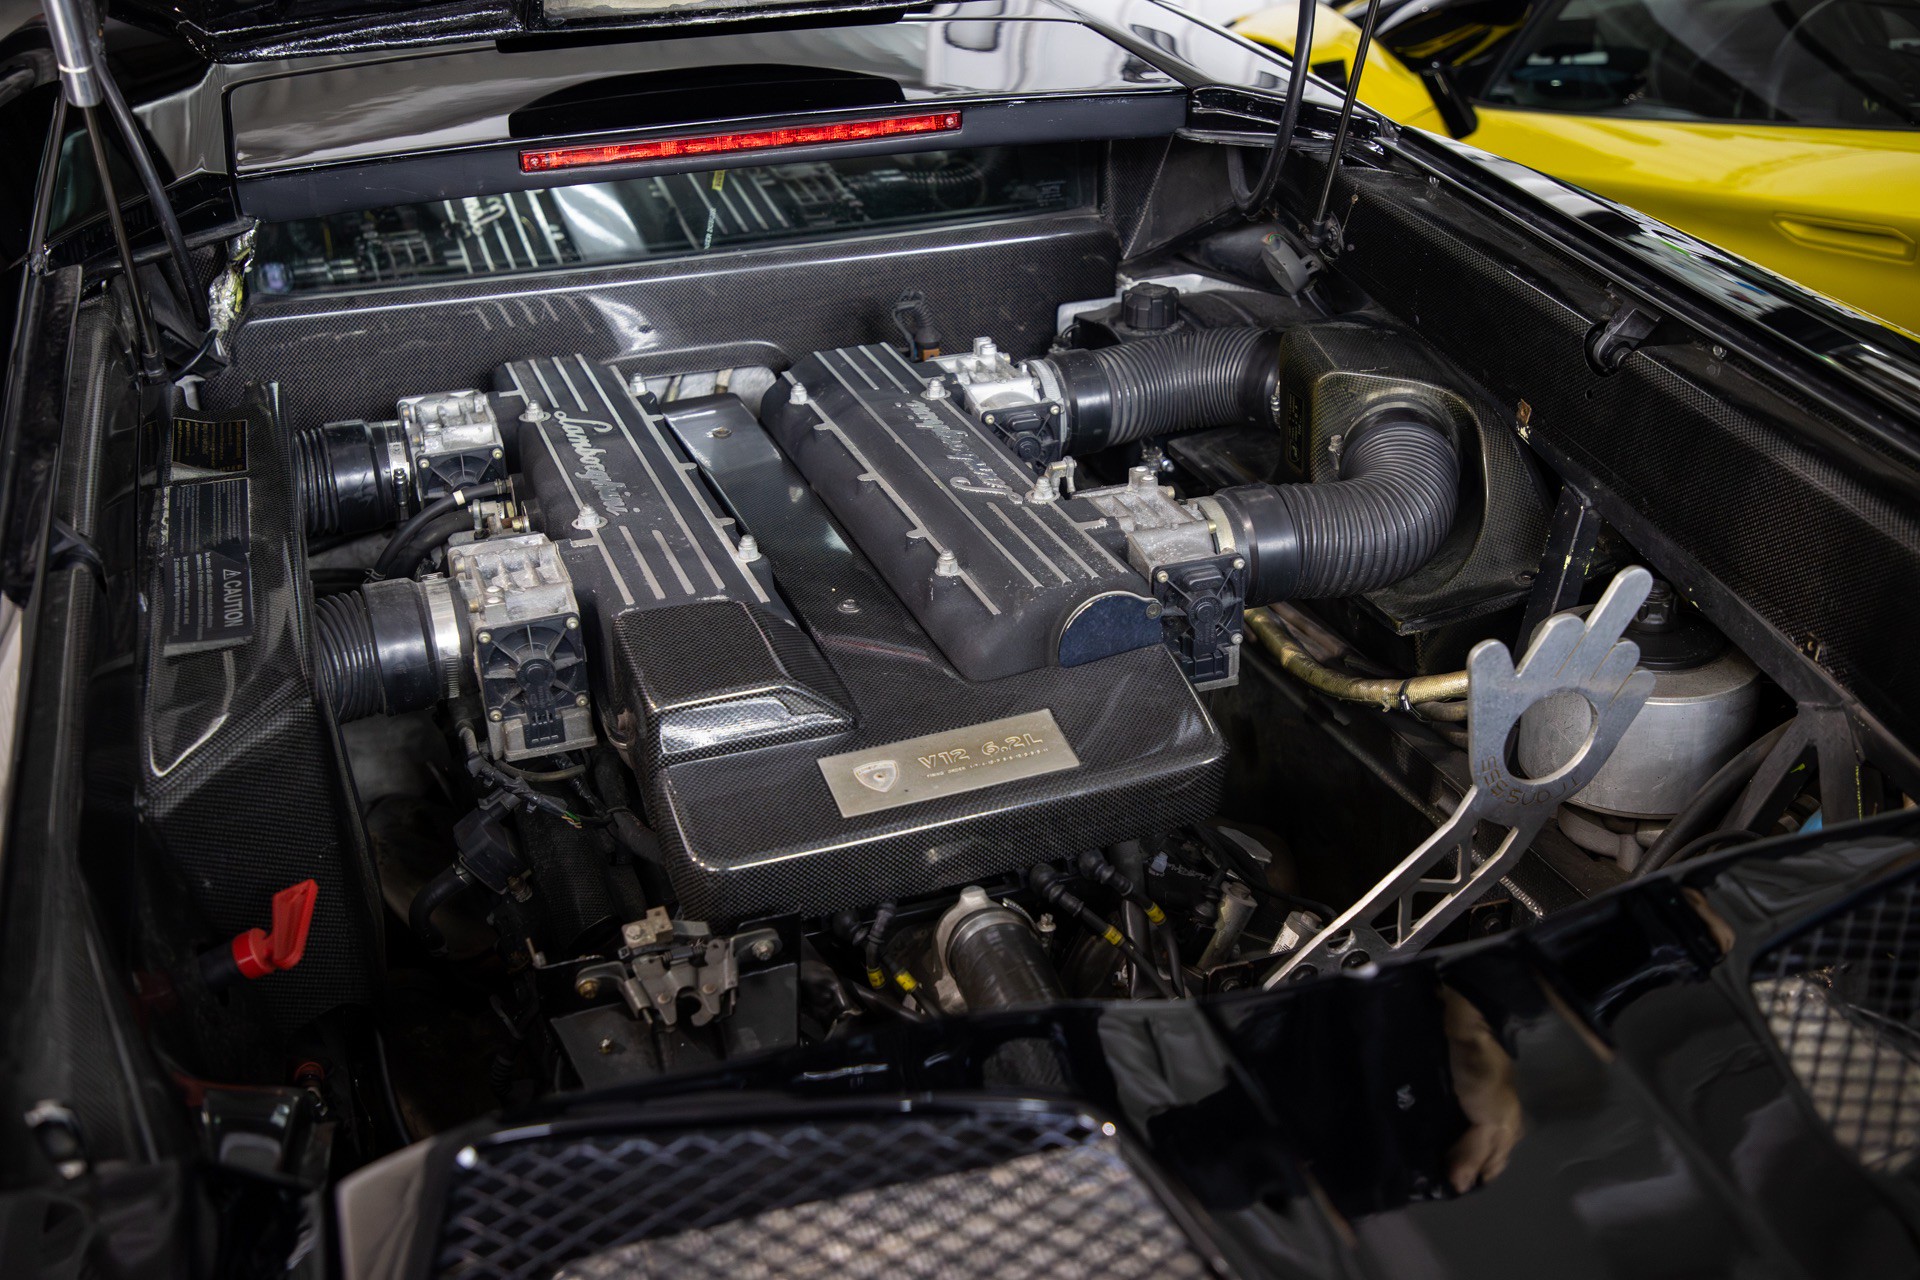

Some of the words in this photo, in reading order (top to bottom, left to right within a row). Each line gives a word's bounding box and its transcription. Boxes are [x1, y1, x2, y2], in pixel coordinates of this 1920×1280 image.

[553, 410, 641, 517] Lamborghini
[224, 580, 244, 627] CAUTION
[917, 748, 970, 769] V12
[981, 733, 1043, 756] 6.2L
